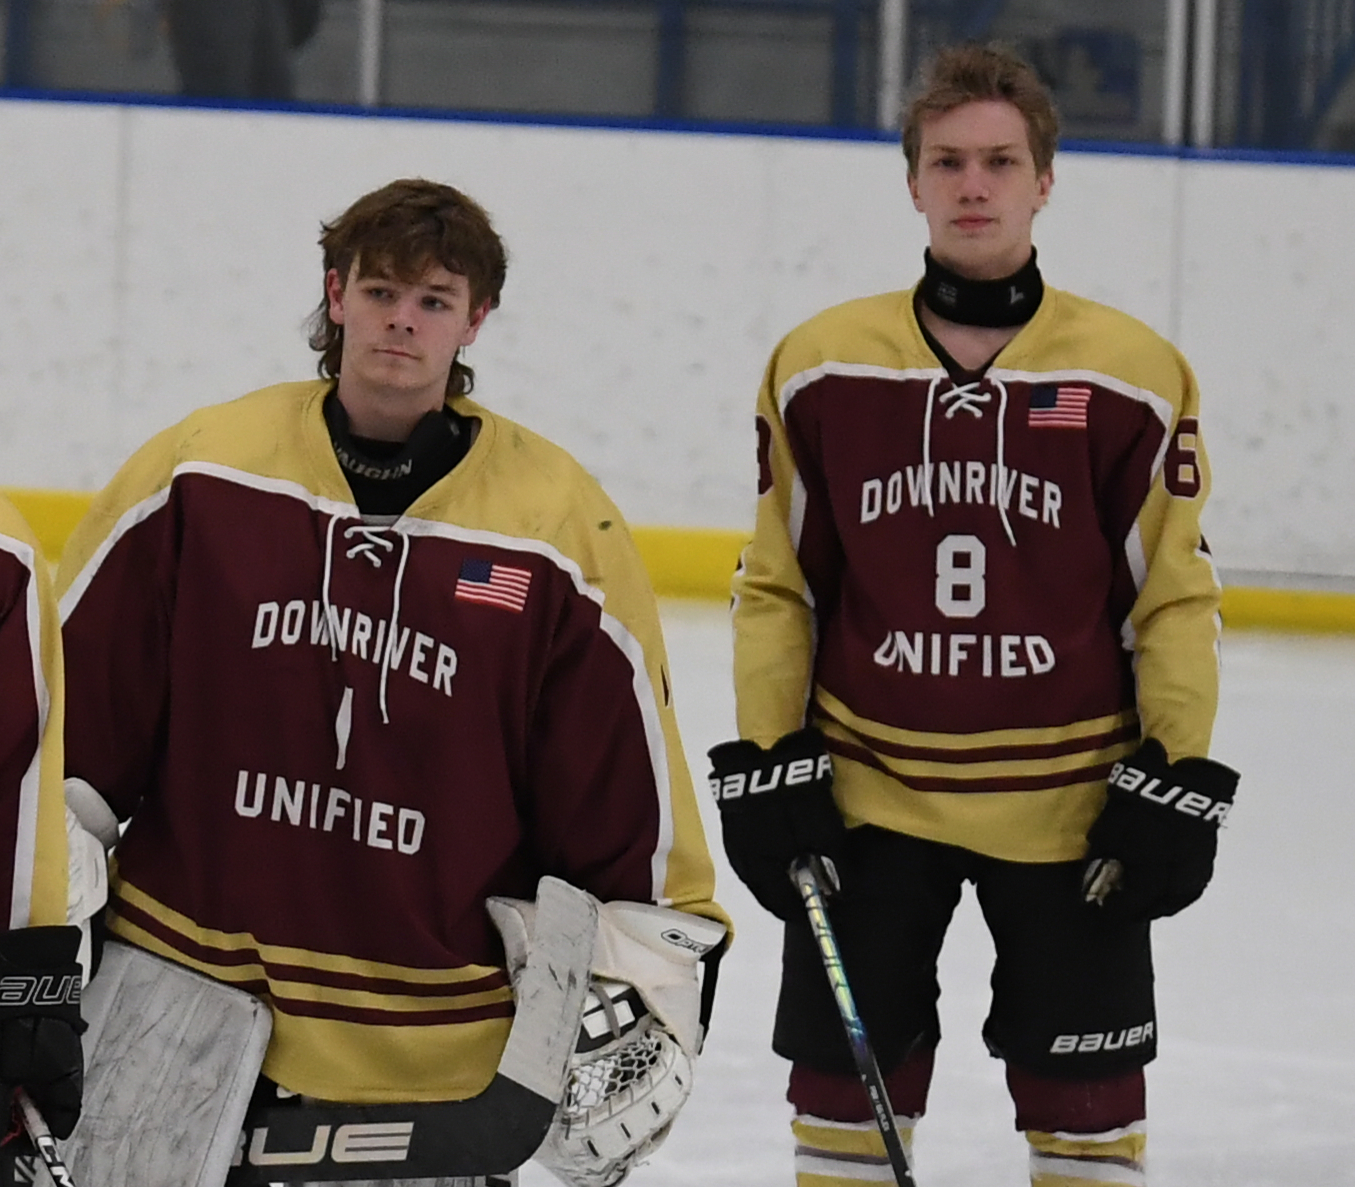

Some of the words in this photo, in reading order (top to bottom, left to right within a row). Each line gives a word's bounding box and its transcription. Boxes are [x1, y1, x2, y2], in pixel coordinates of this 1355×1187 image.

[334, 443, 412, 480] AUGHN
[860, 461, 1062, 529] DOWNRIVER
[934, 533, 987, 618] 8
[251, 600, 459, 697] DOWNRIVER
[874, 630, 1056, 678] UNIFIED
[233, 770, 426, 856] UNIFIED
[1050, 1020, 1154, 1054] BAUER
